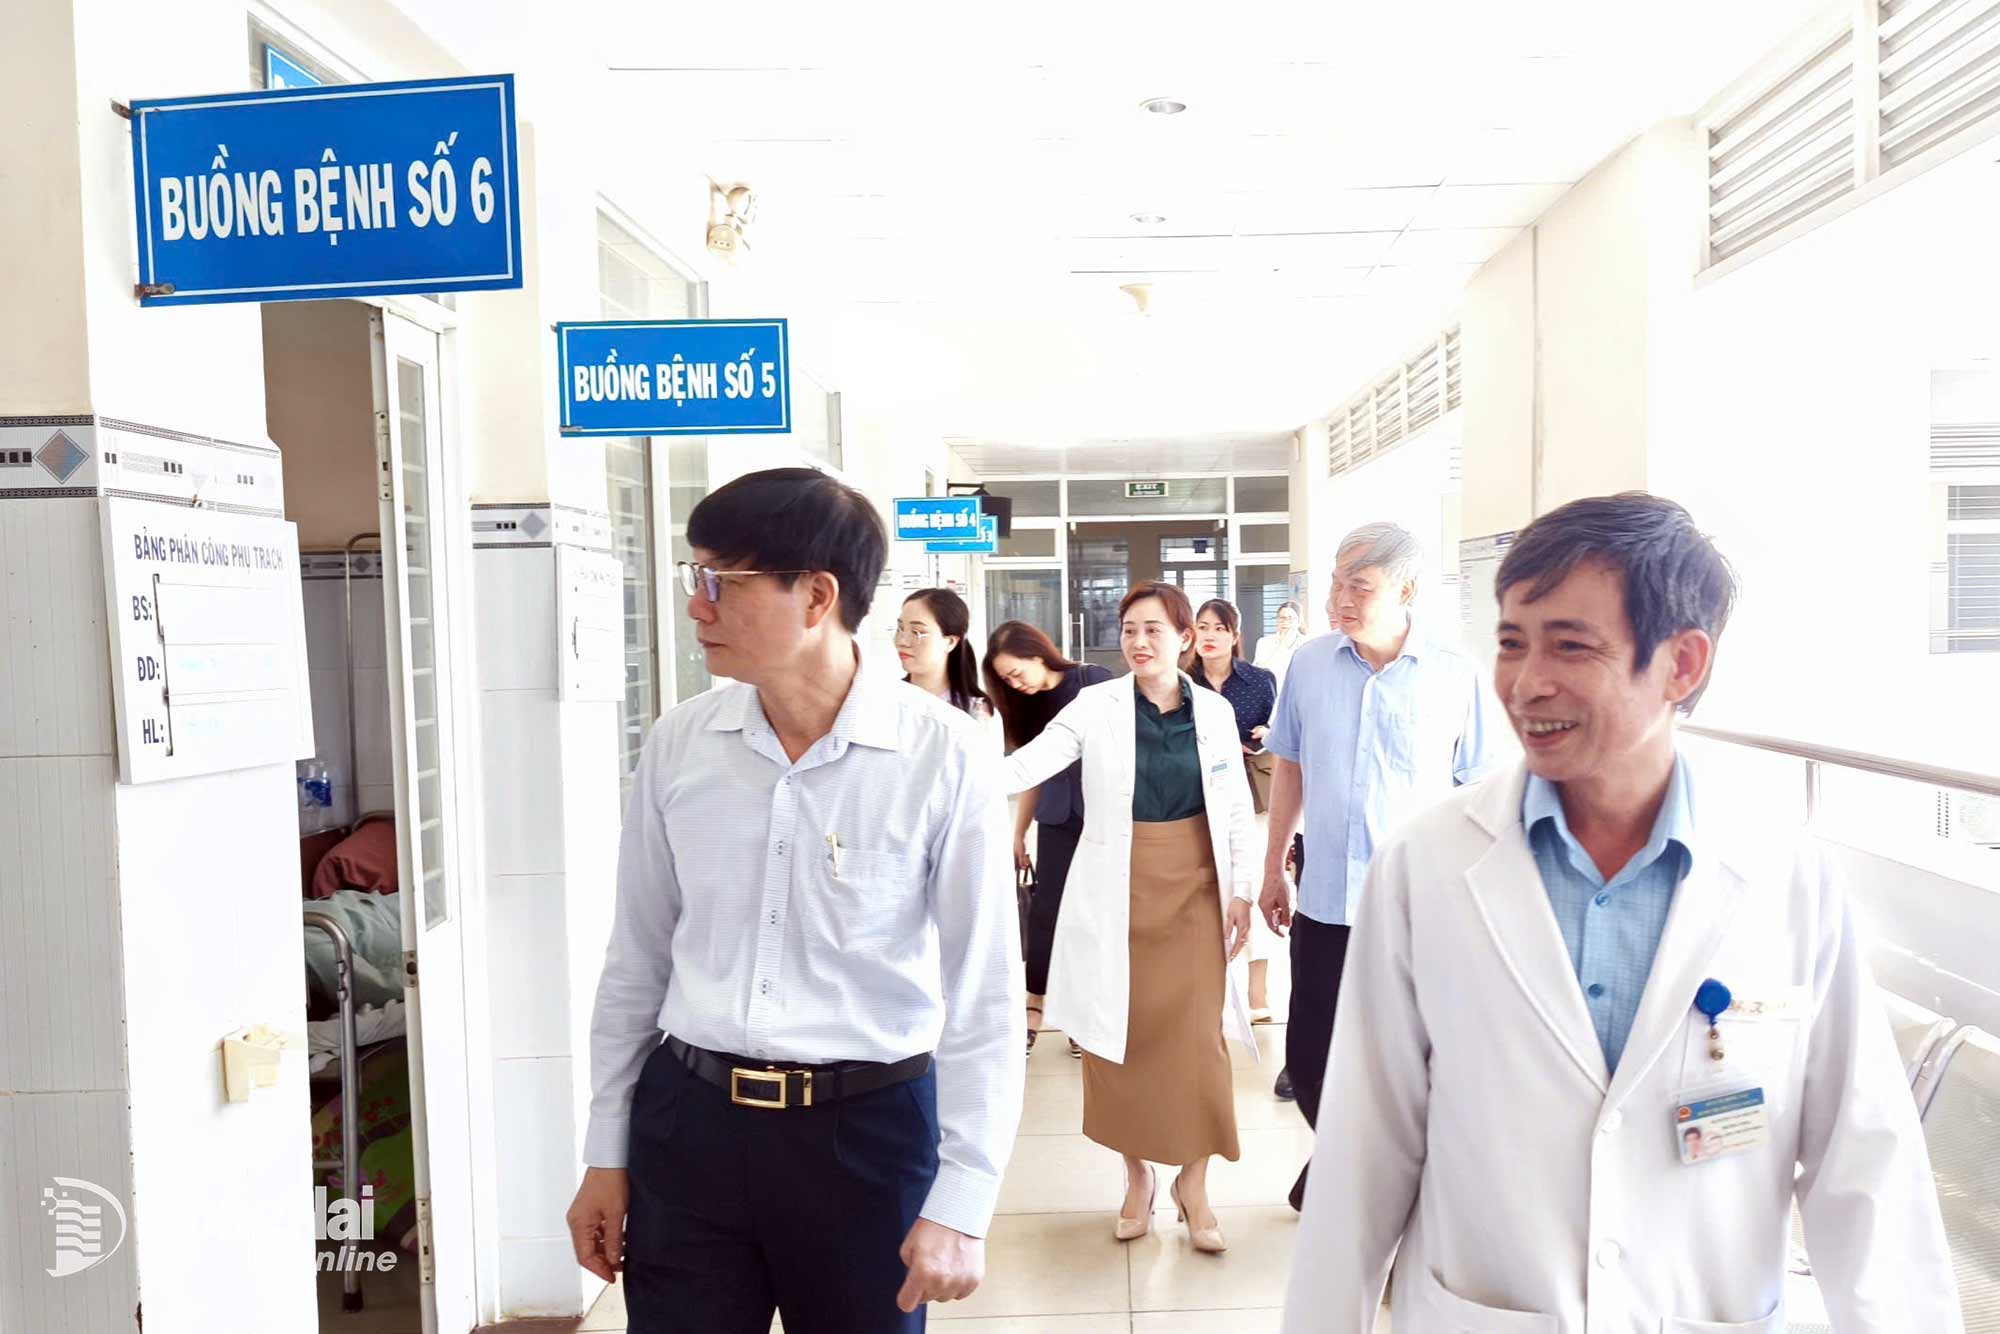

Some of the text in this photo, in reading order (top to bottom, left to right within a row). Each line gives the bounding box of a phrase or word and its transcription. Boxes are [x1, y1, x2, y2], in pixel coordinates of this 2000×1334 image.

[160, 131, 495, 246] BUỒNG BỆNH SỐ 6
[574, 348, 776, 407] BUỒNG BỆNH SỐ 5
[134, 526, 166, 562] BẢNG
[169, 533, 199, 564] PHÂN
[201, 537, 229, 566] CÔNG
[132, 595, 153, 621] BS:
[136, 656, 160, 681] ĐD:
[142, 718, 164, 744] HL:
